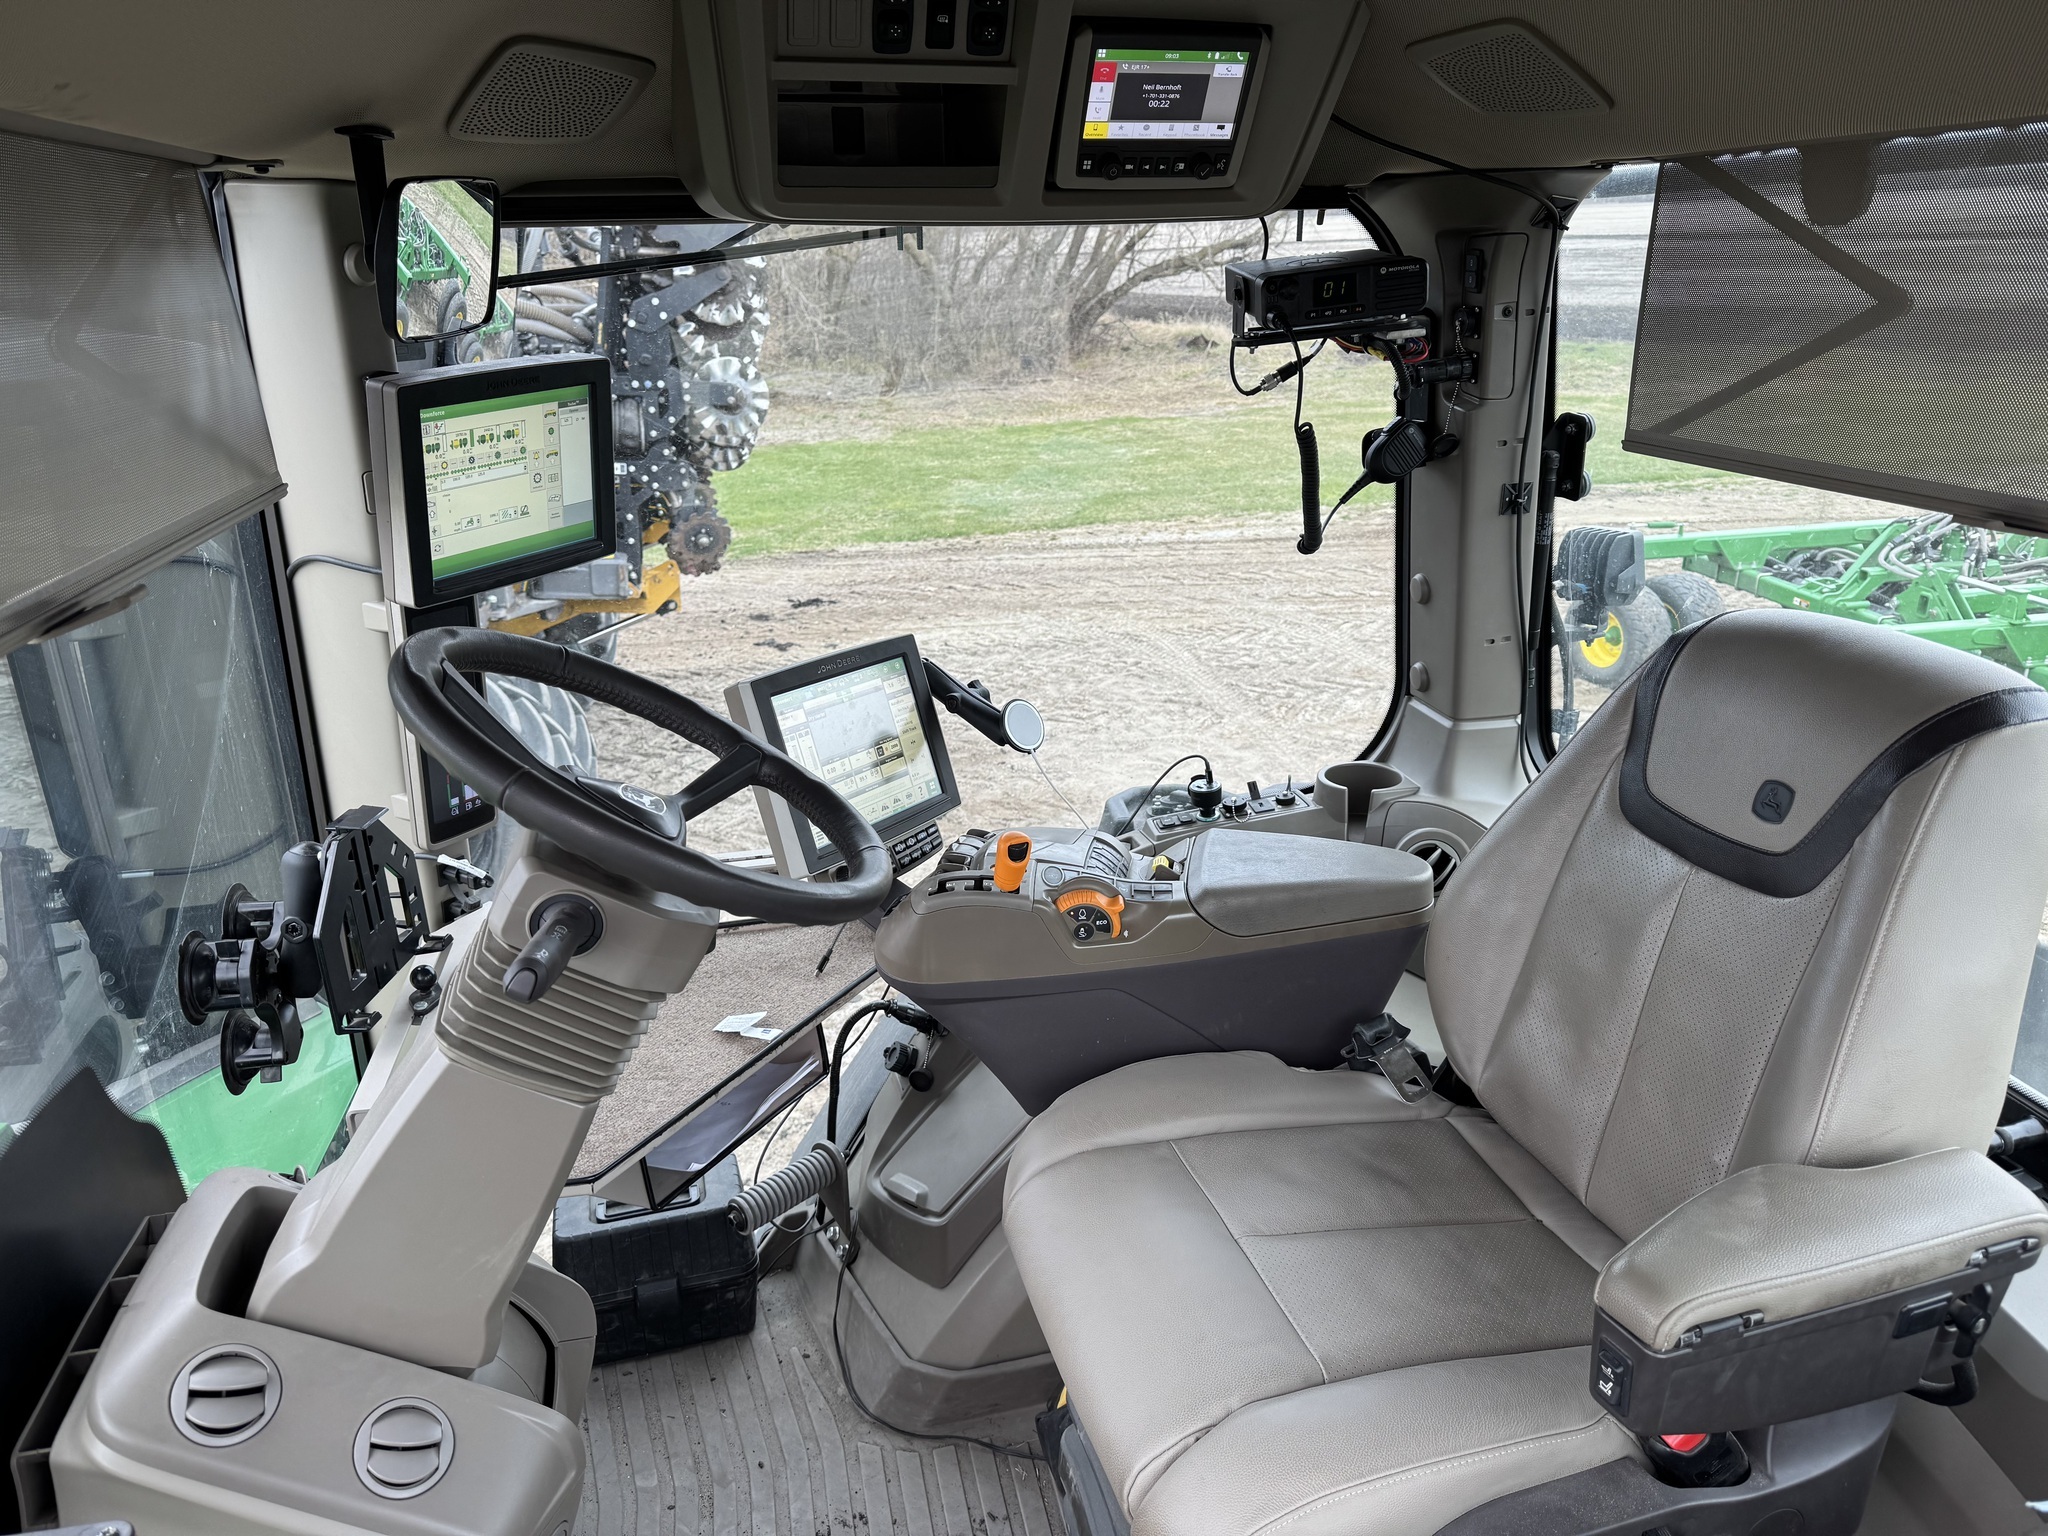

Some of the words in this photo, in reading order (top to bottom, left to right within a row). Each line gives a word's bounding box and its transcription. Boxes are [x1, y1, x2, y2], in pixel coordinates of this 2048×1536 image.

[1148, 100, 1171, 108] 00:22
[1388, 264, 1420, 272] MOTOROLA
[420, 410, 445, 418] Downforce
[817, 662, 837, 674] JOHN
[836, 655, 861, 668] DEERE
